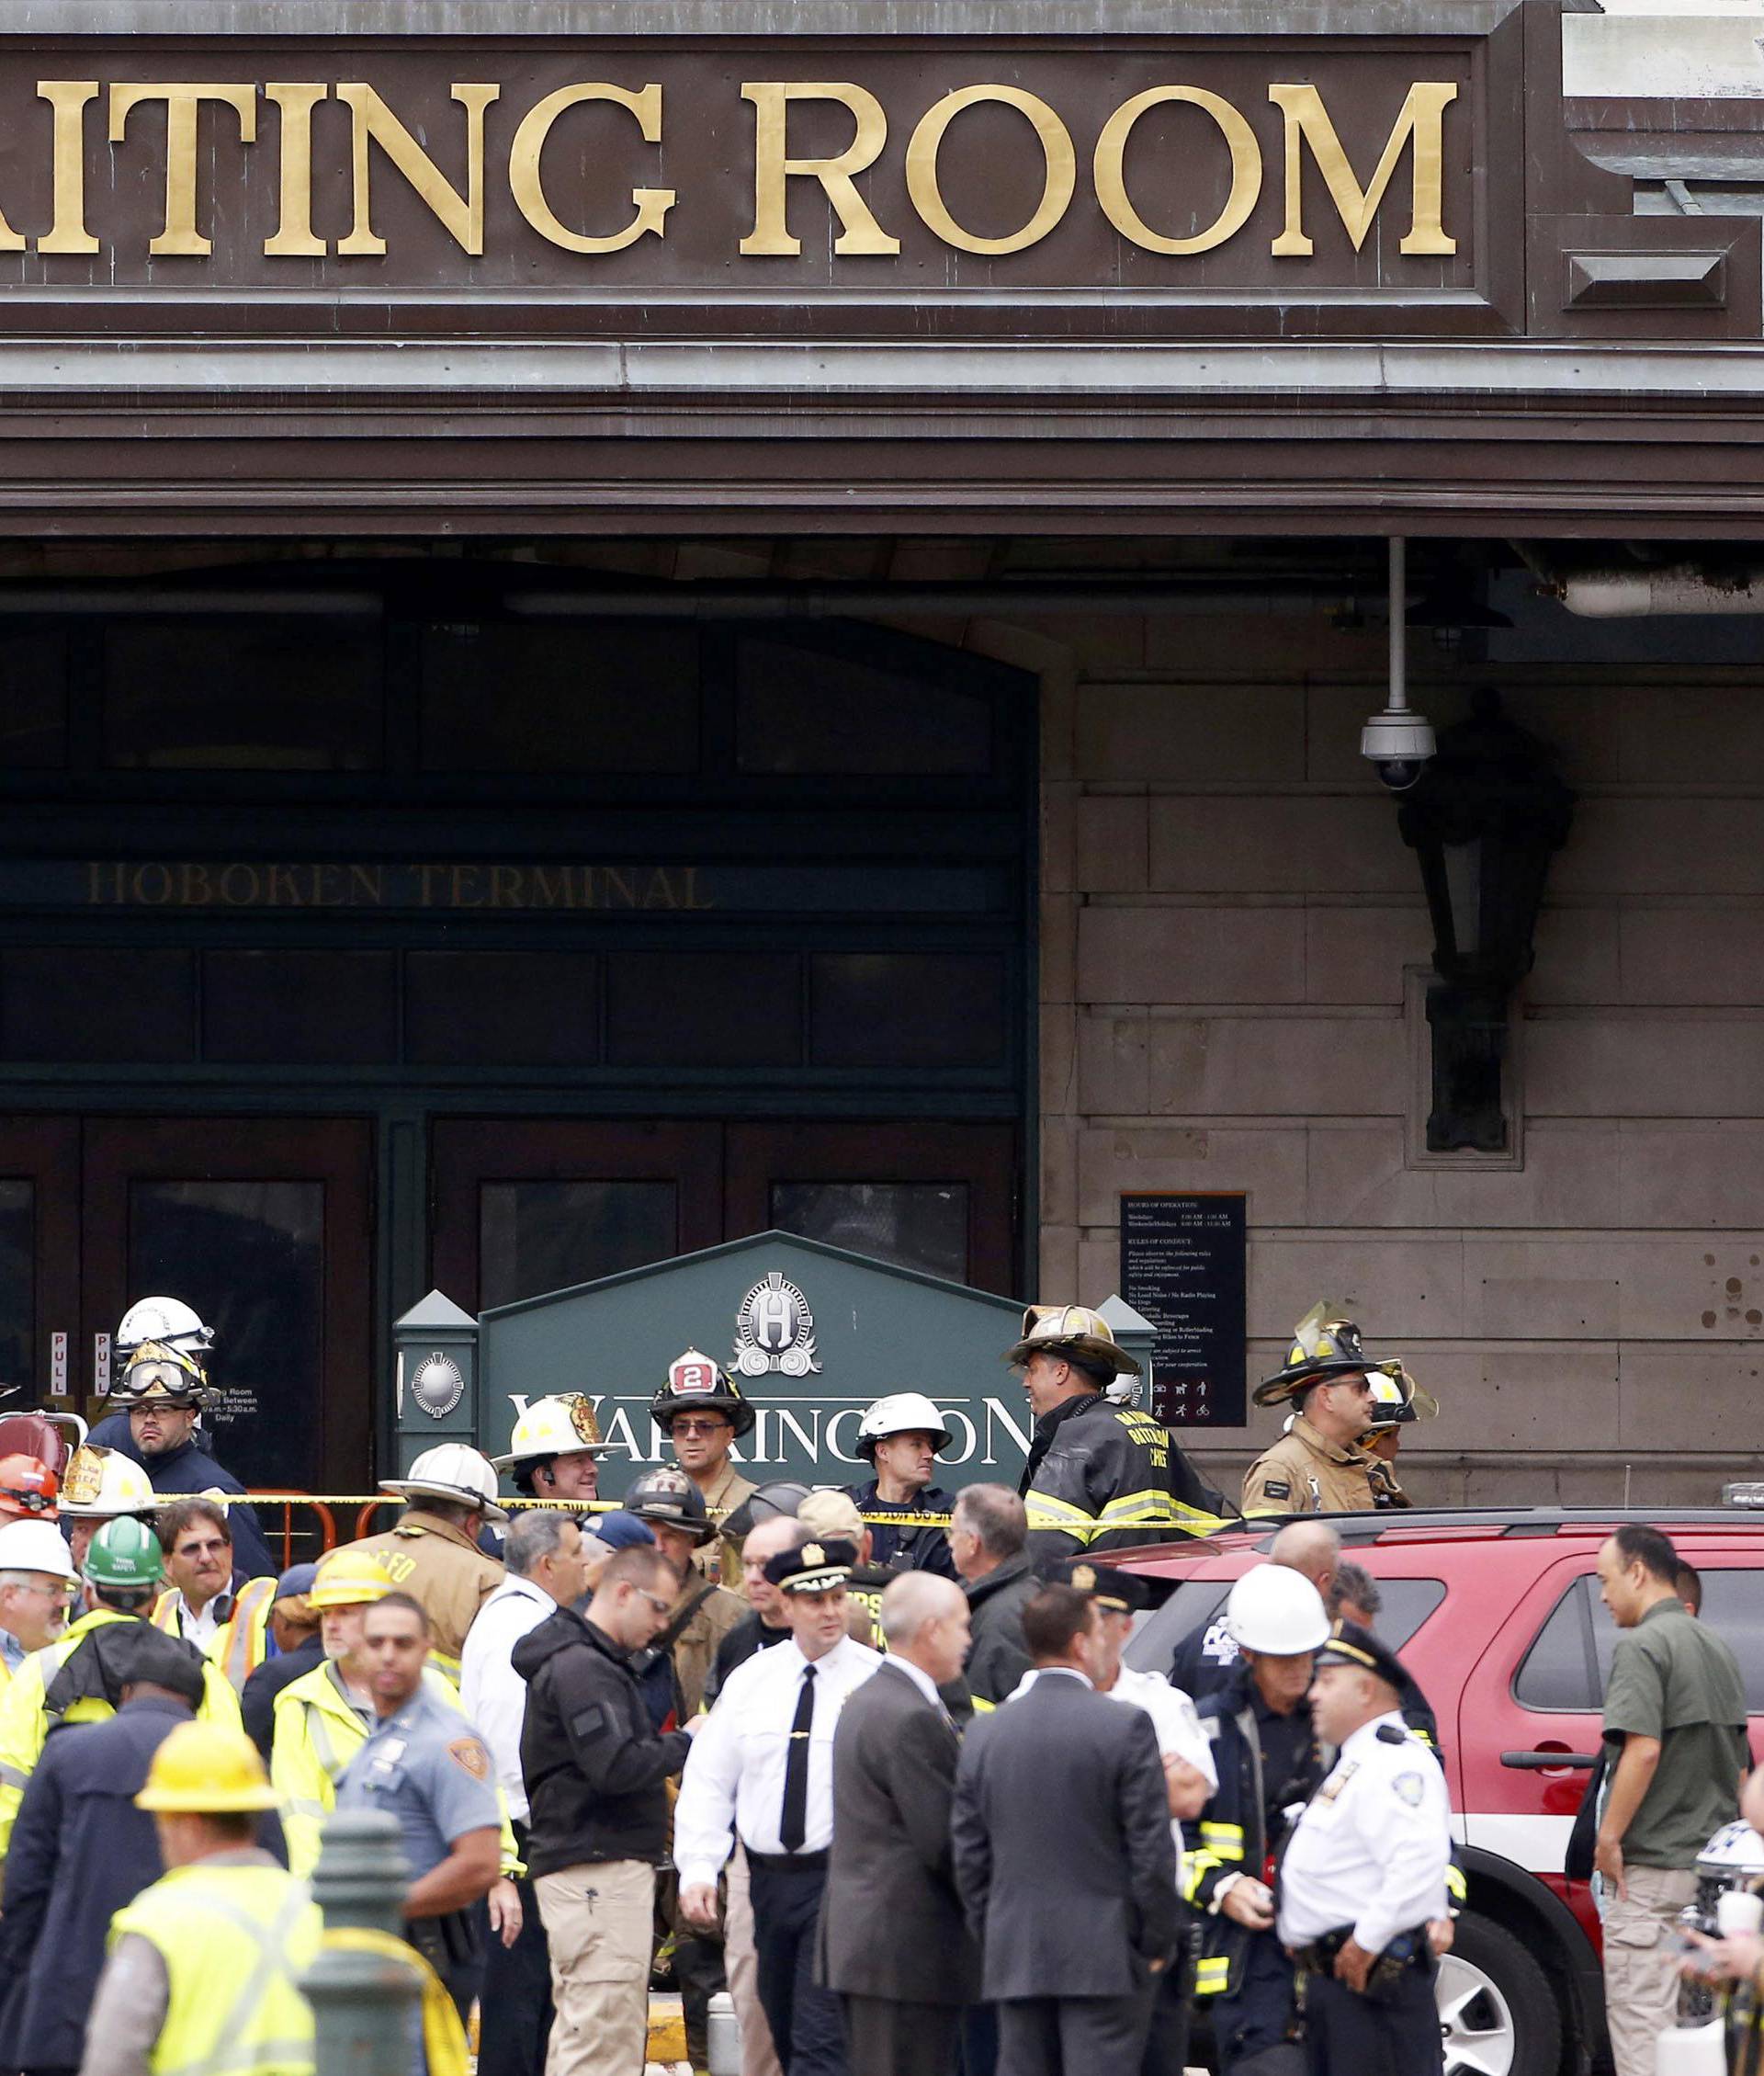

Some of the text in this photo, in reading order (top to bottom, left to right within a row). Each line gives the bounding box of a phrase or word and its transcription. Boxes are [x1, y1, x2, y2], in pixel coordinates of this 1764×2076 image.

[0, 81, 1458, 256] ITING ROOM
[86, 861, 716, 910] HOBOKEN TERMINAL
[757, 1290, 794, 1349] H
[55, 1335, 63, 1393] PULL
[97, 1335, 106, 1393] PULL
[684, 1366, 702, 1388] 2
[223, 1396, 257, 1404] Between
[229, 1388, 253, 1396] Room
[215, 1413, 235, 1423] Daily
